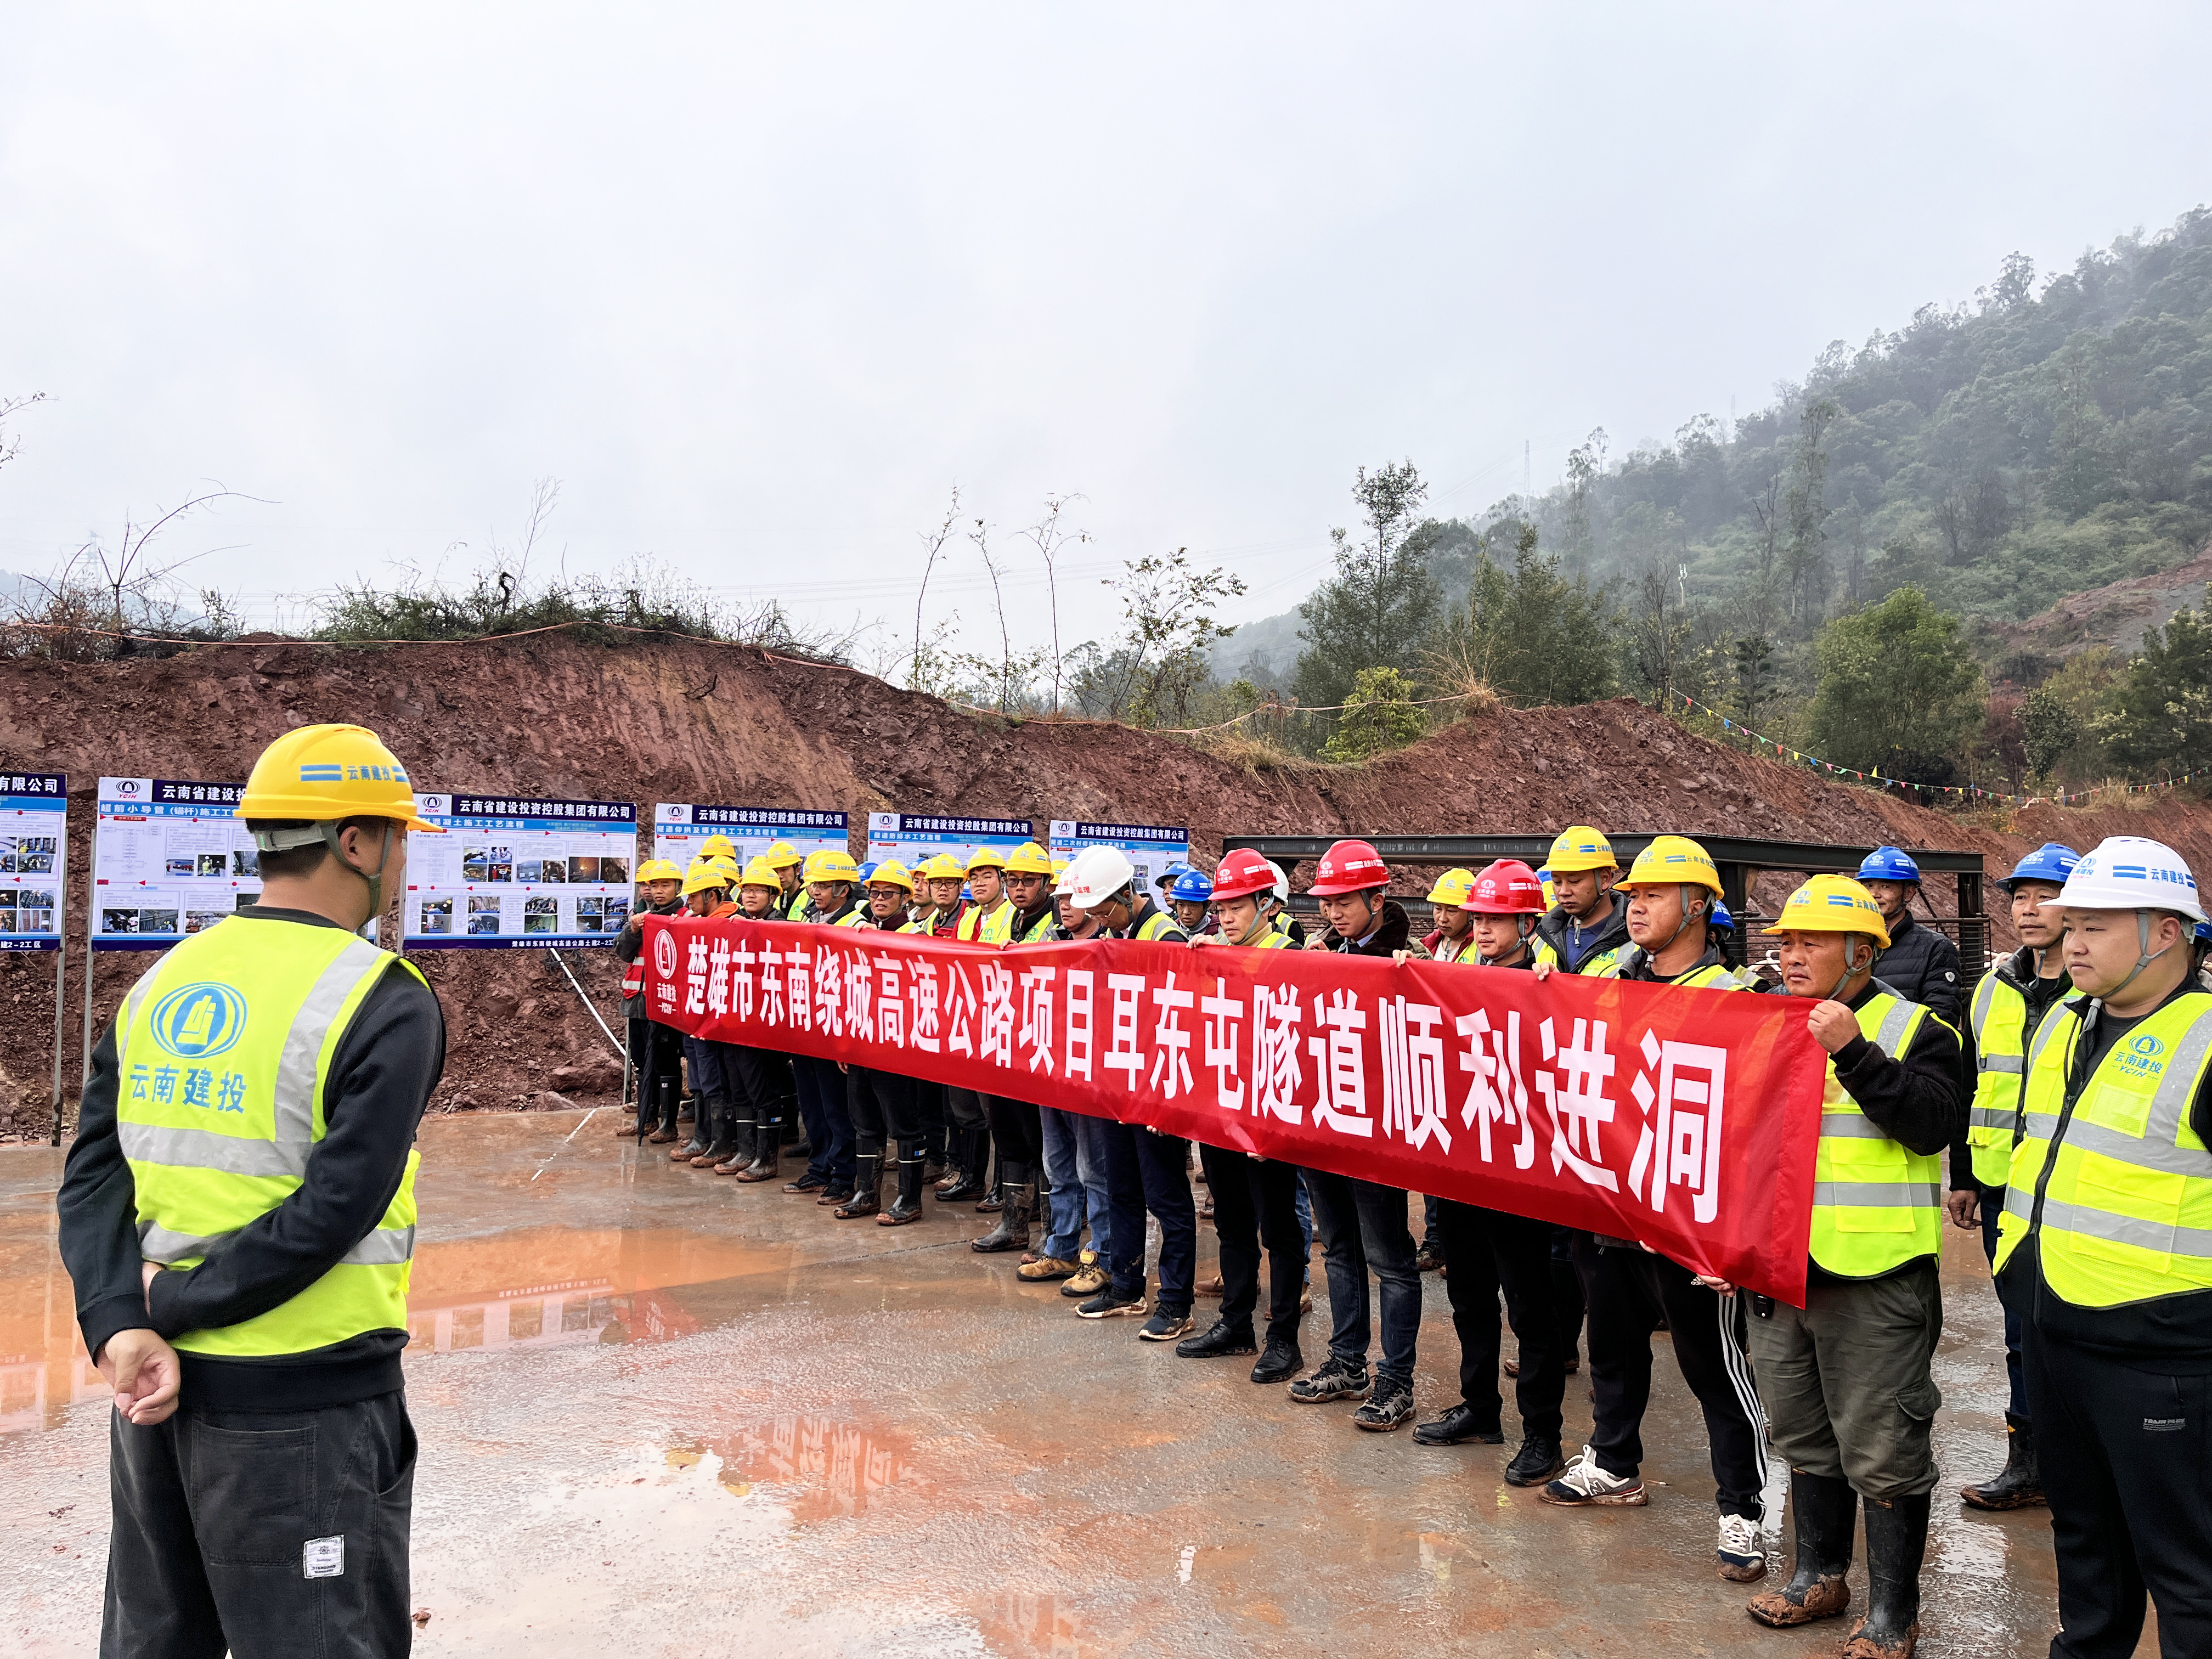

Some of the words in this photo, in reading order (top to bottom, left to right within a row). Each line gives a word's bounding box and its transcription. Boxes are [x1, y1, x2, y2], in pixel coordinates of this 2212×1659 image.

[347, 765, 391, 781] 云南建投
[0, 776, 57, 793] 有限公司
[100, 803, 235, 817] 超前小导管(锚杆)施工工
[460, 800, 630, 819] 云南省建设投资控股集团有限公司
[698, 809, 842, 826] 云南省建设投资控股集团有限公司
[905, 817, 1029, 833] 云南省建设投资控股集团有限公司
[1080, 825, 1184, 840] 云南省建设投资控股集团有限公司
[2150, 868, 2185, 885] 云南建投
[657, 982, 677, 1003] 云南建投
[2114, 1051, 2163, 1075] 云南建投
[685, 935, 1727, 1223] 楚雄市东南绕城高速公路项目耳东屯隧道顺利进洞
[129, 1063, 247, 1115] 云南建投
